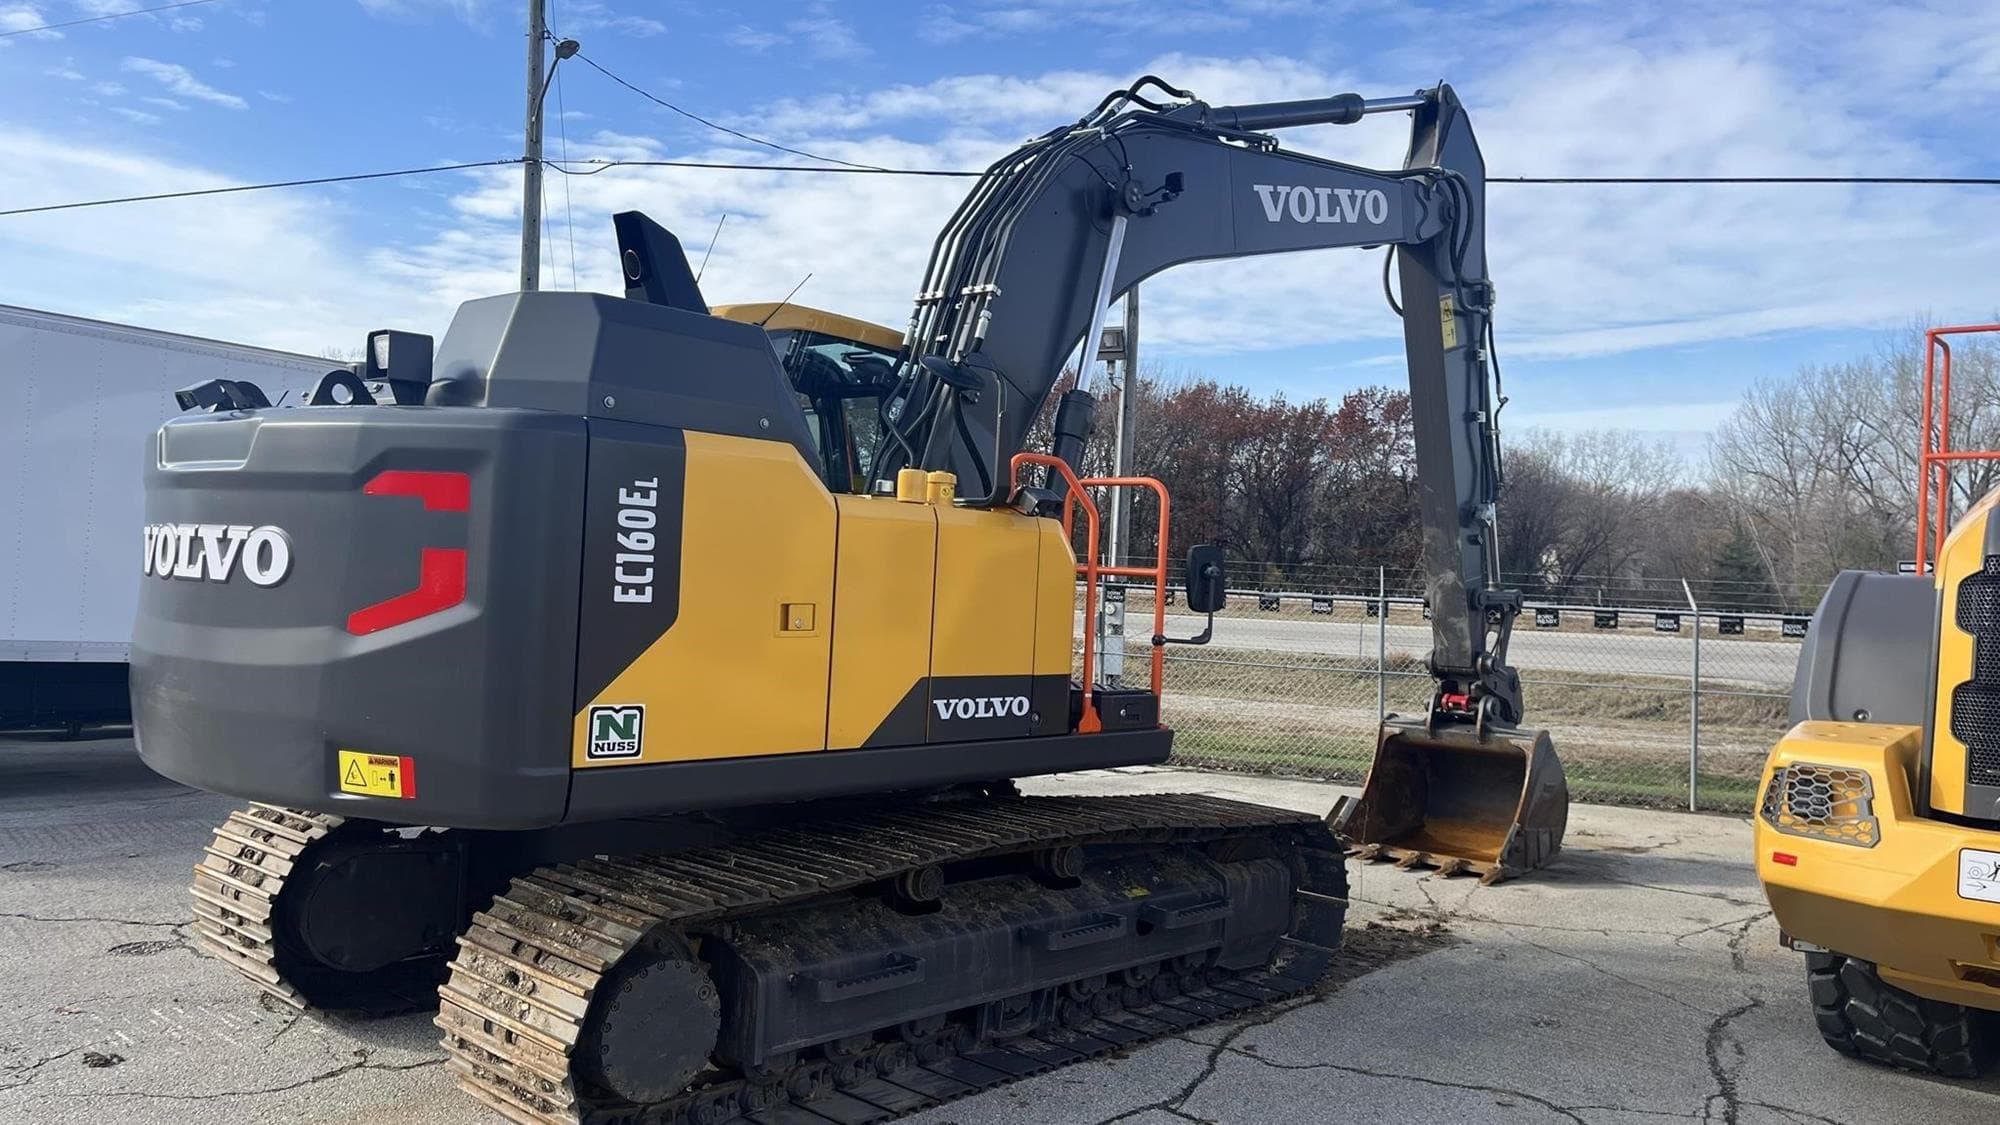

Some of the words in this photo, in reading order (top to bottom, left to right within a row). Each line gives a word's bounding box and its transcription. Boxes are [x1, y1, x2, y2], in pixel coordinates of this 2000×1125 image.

[1253, 184, 1388, 225] VOLVO
[144, 523, 292, 586] VOLVO
[613, 477, 658, 603] EC160EL
[933, 696, 1030, 720] VOLVO
[595, 713, 637, 741] N
[594, 741, 636, 752] NUSS
